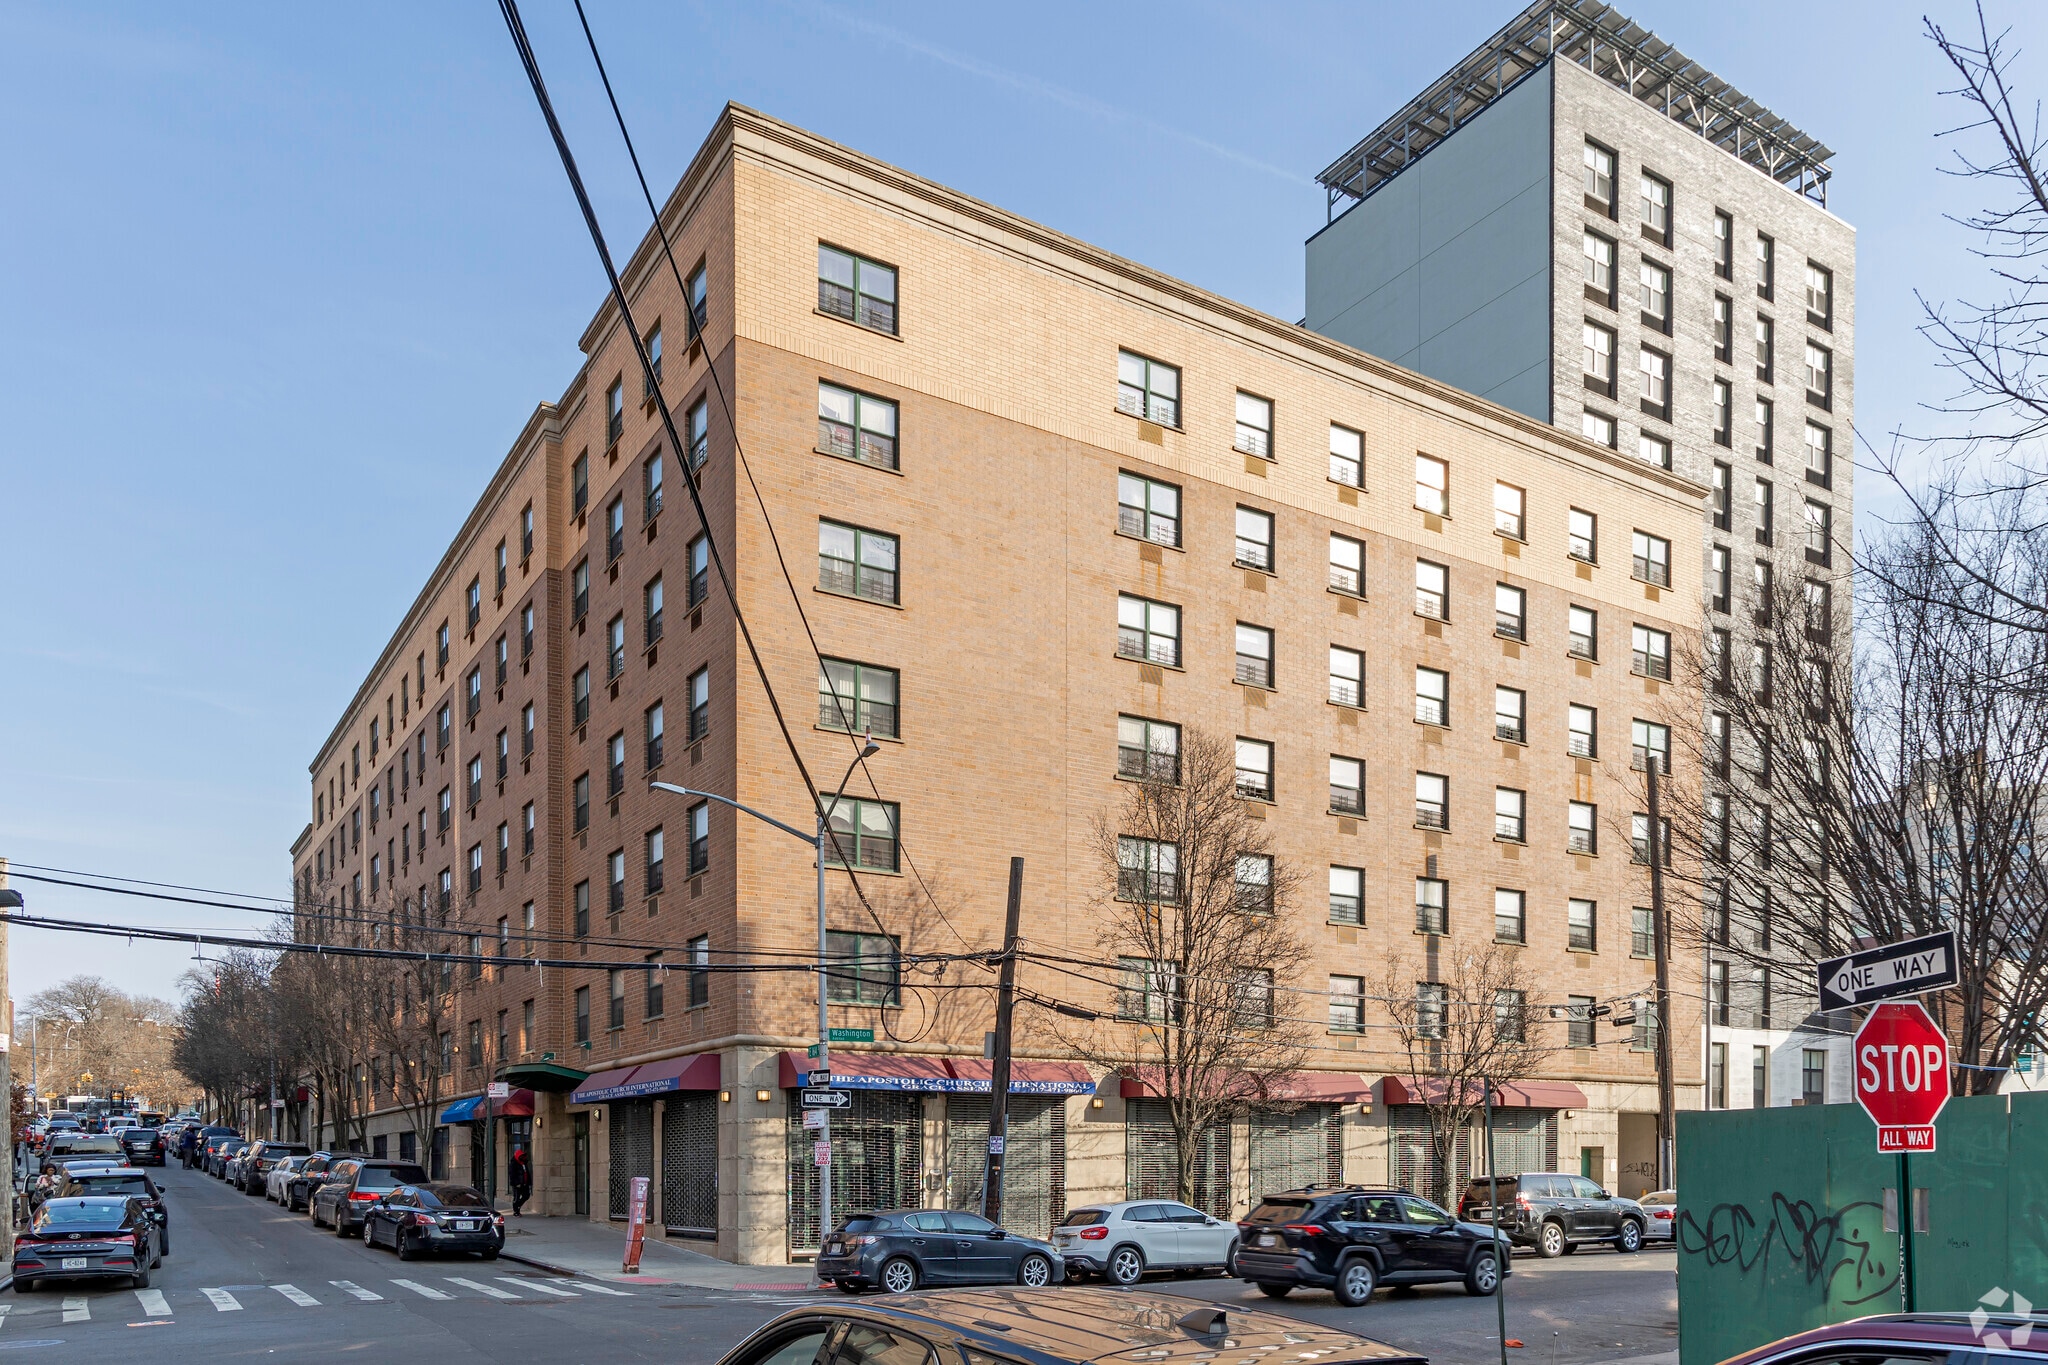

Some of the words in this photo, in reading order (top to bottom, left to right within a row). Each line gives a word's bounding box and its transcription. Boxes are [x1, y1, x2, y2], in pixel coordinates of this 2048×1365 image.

[1838, 967, 1875, 992] ONE
[1893, 952, 1936, 980] WAY
[832, 1029, 871, 1038] Washington
[1861, 1044, 1943, 1093] STOP
[586, 1089, 609, 1097] APOSTOLIC
[609, 1085, 630, 1095] CHURCH
[630, 1079, 671, 1092] INTERNATIONAL
[829, 1075, 855, 1083] THE
[857, 1076, 933, 1086] APOSTOLIC
[936, 1079, 990, 1088] CHURCH
[1009, 1081, 1091, 1090] TERNATIONAL
[809, 1094, 824, 1102] ONE
[1882, 1131, 1903, 1146] ALL
[1907, 1130, 1930, 1146] WAY
